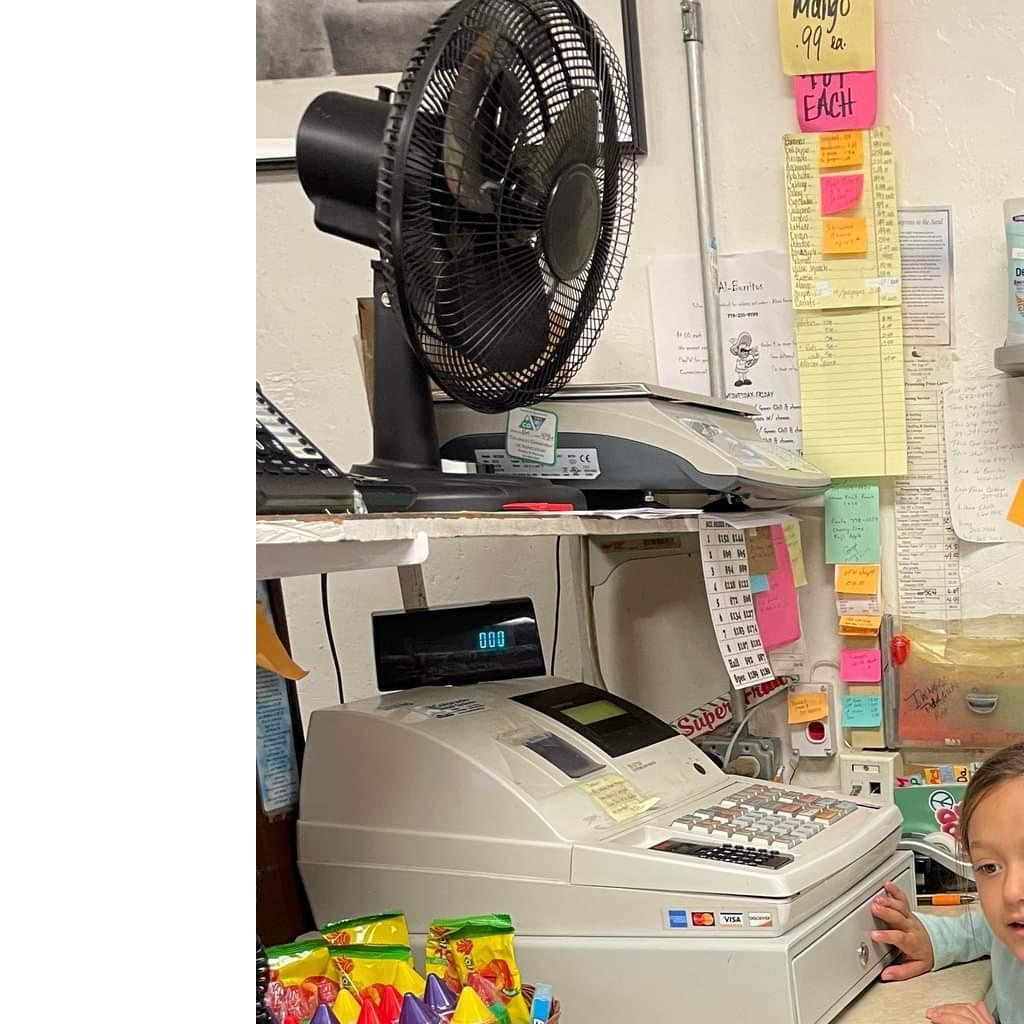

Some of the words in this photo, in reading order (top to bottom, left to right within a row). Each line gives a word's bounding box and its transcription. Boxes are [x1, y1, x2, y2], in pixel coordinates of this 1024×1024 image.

[804, 88, 856, 121] EACH
[677, 700, 732, 737] Super
[723, 915, 741, 923] VISA
